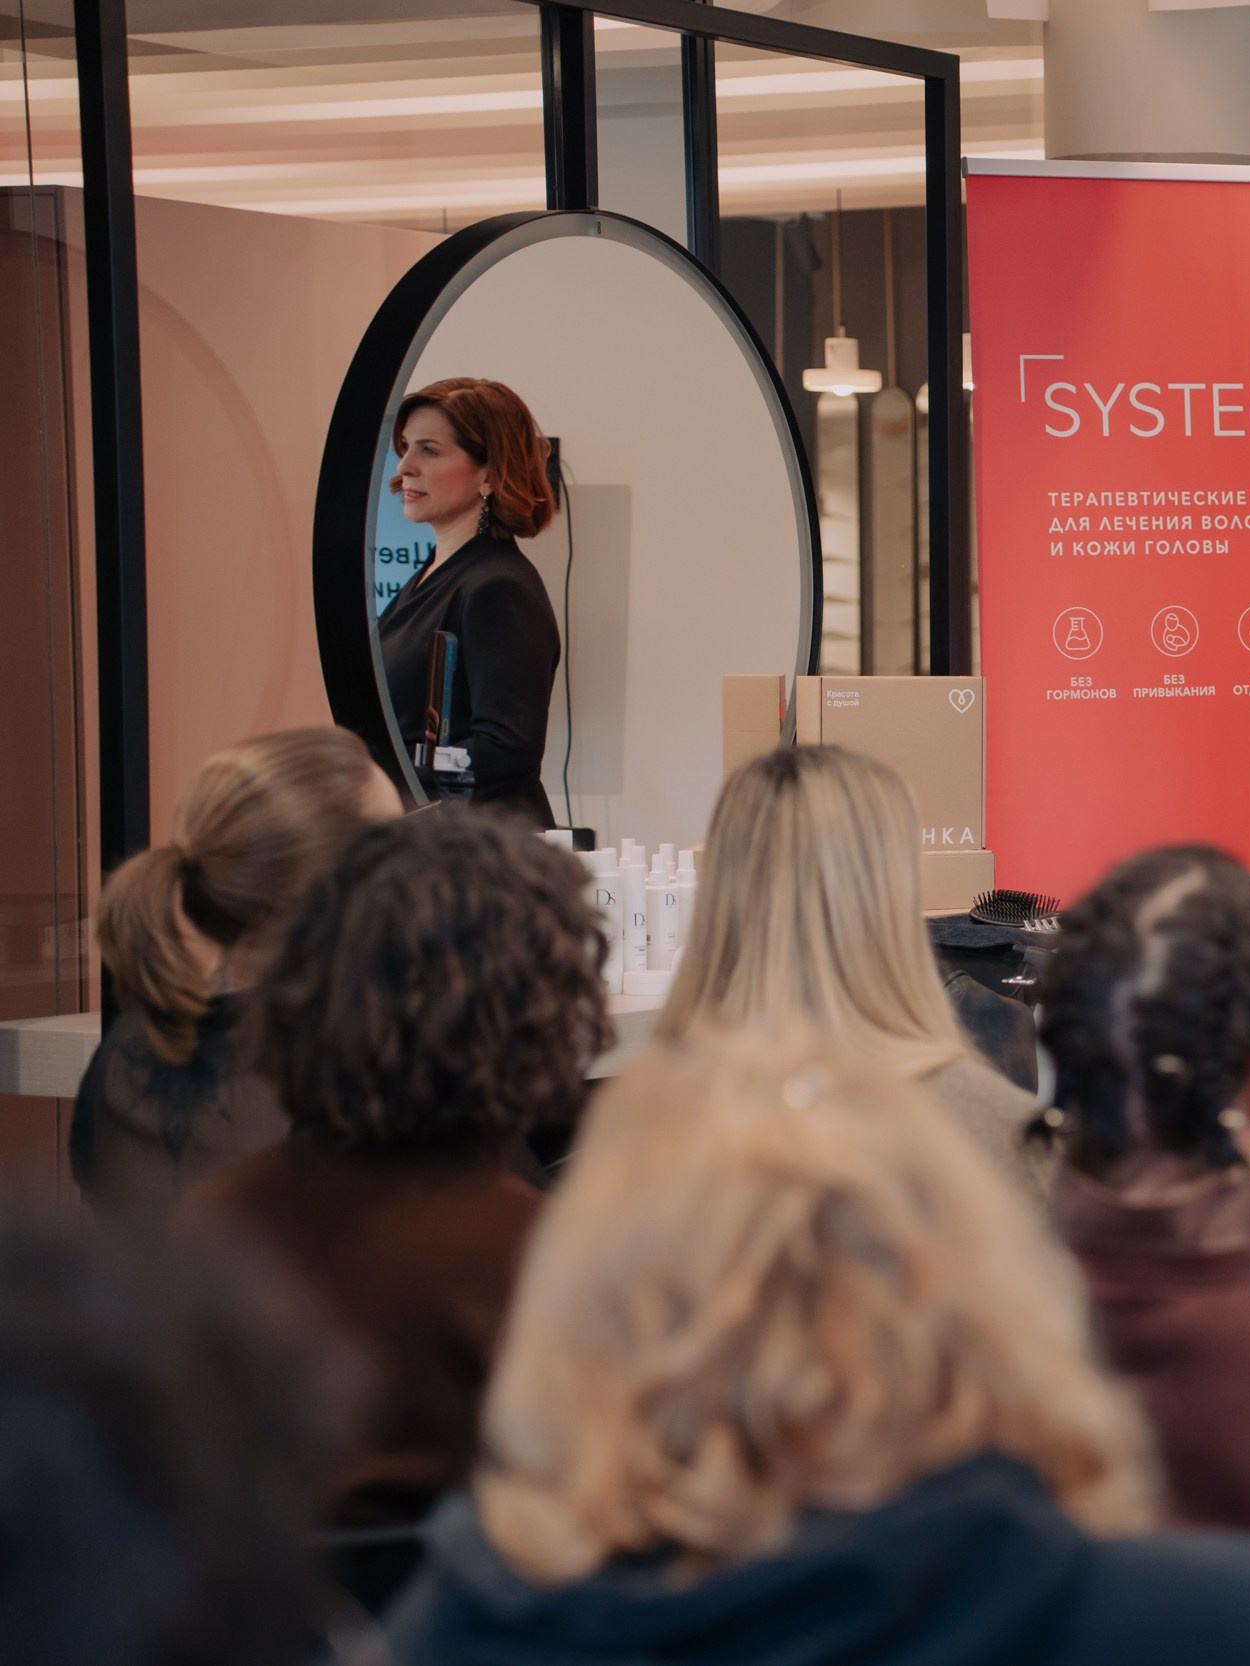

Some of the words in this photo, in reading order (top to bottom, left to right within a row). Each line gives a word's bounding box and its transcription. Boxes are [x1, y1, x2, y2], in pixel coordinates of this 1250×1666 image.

[1048, 490, 1247, 507] ТЕРАПЕВТИЧЕСКИЕ
[1048, 516, 1090, 534] ДЛЯ
[1099, 515, 1192, 531] ЛЕЧЕНИЯ
[1050, 542, 1063, 556] И
[1072, 541, 1136, 556] КОЖИ
[1145, 540, 1229, 555] ГОЛОВЫ
[1070, 676, 1093, 687] БЕЗ
[1163, 674, 1185, 685] БЕЗ
[826, 690, 859, 698] Красота
[1046, 688, 1117, 700] ГОРМОНОВ
[1133, 686, 1216, 698] ПРИВЫКАНИЯ
[833, 699, 859, 707] душой
